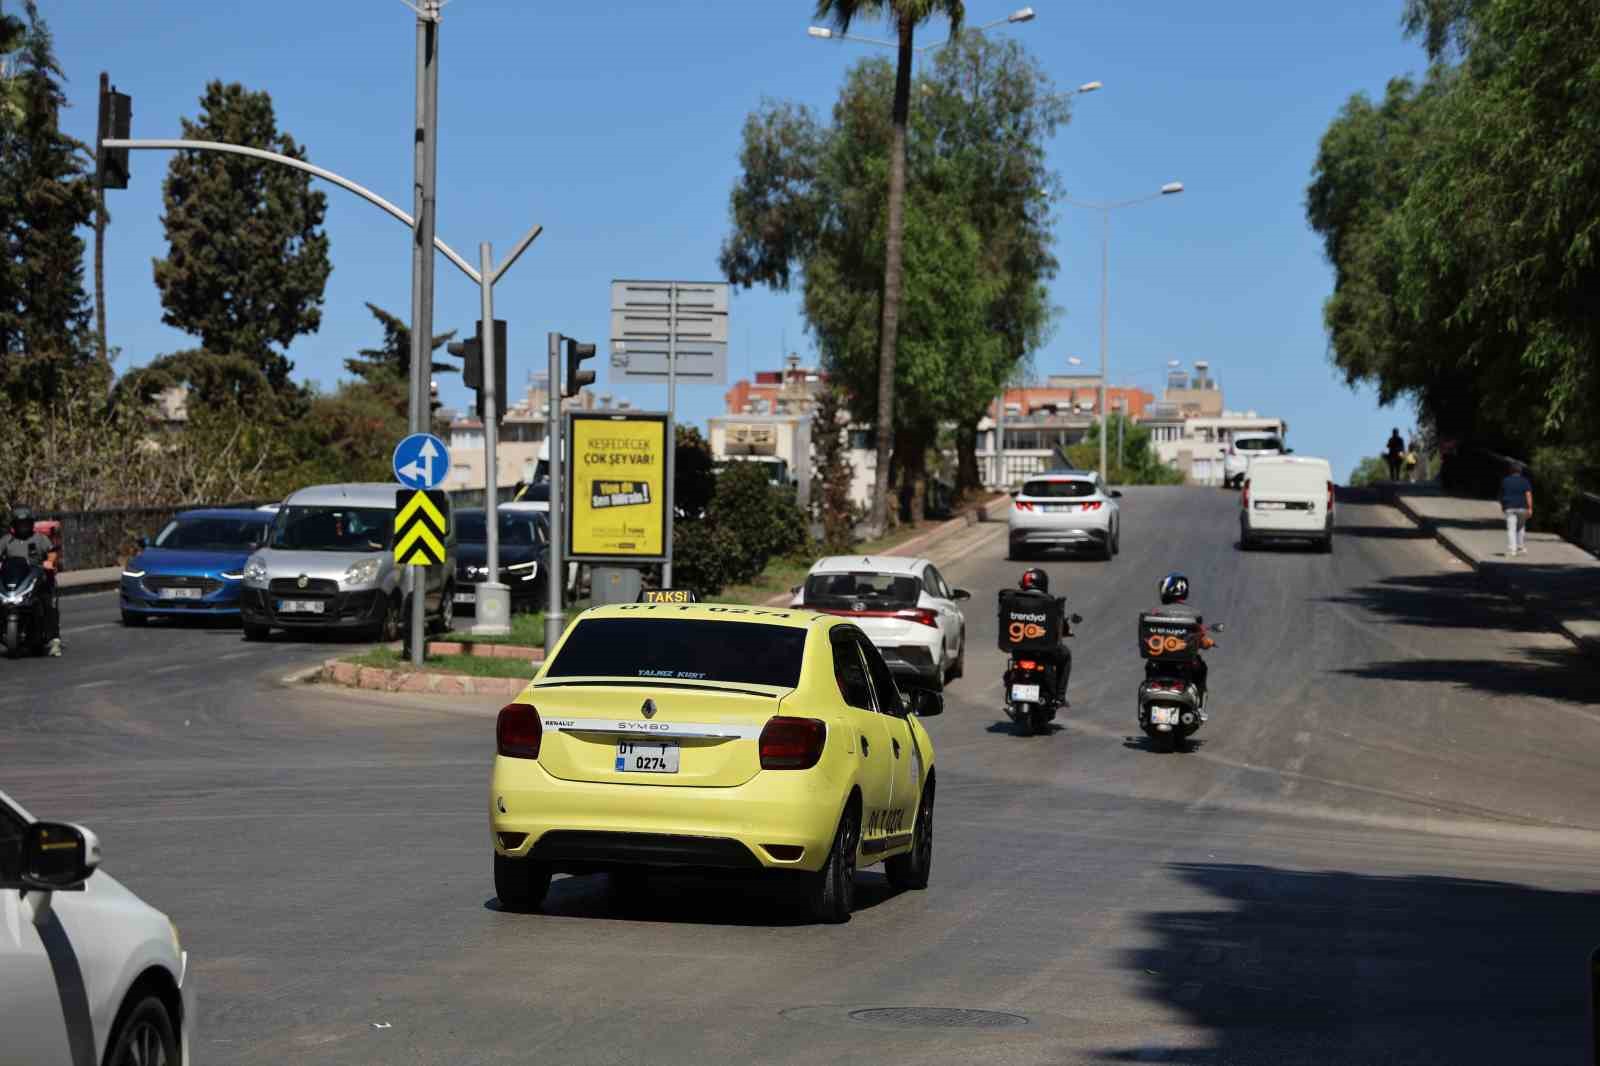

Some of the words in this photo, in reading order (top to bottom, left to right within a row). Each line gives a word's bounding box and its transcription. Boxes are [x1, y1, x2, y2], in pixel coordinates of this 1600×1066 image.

[584, 453, 606, 466] ÇOK
[609, 453, 627, 466] ŞEY
[629, 453, 655, 465] VAR!
[708, 607, 791, 619] 0274
[1010, 612, 1047, 622] trendyol
[1009, 622, 1047, 643] go
[1148, 635, 1187, 656] go
[677, 671, 706, 679] KURT
[618, 722, 670, 731] SYMBO
[620, 741, 634, 754] 01
[659, 743, 669, 755] T
[636, 756, 666, 769] 0274
